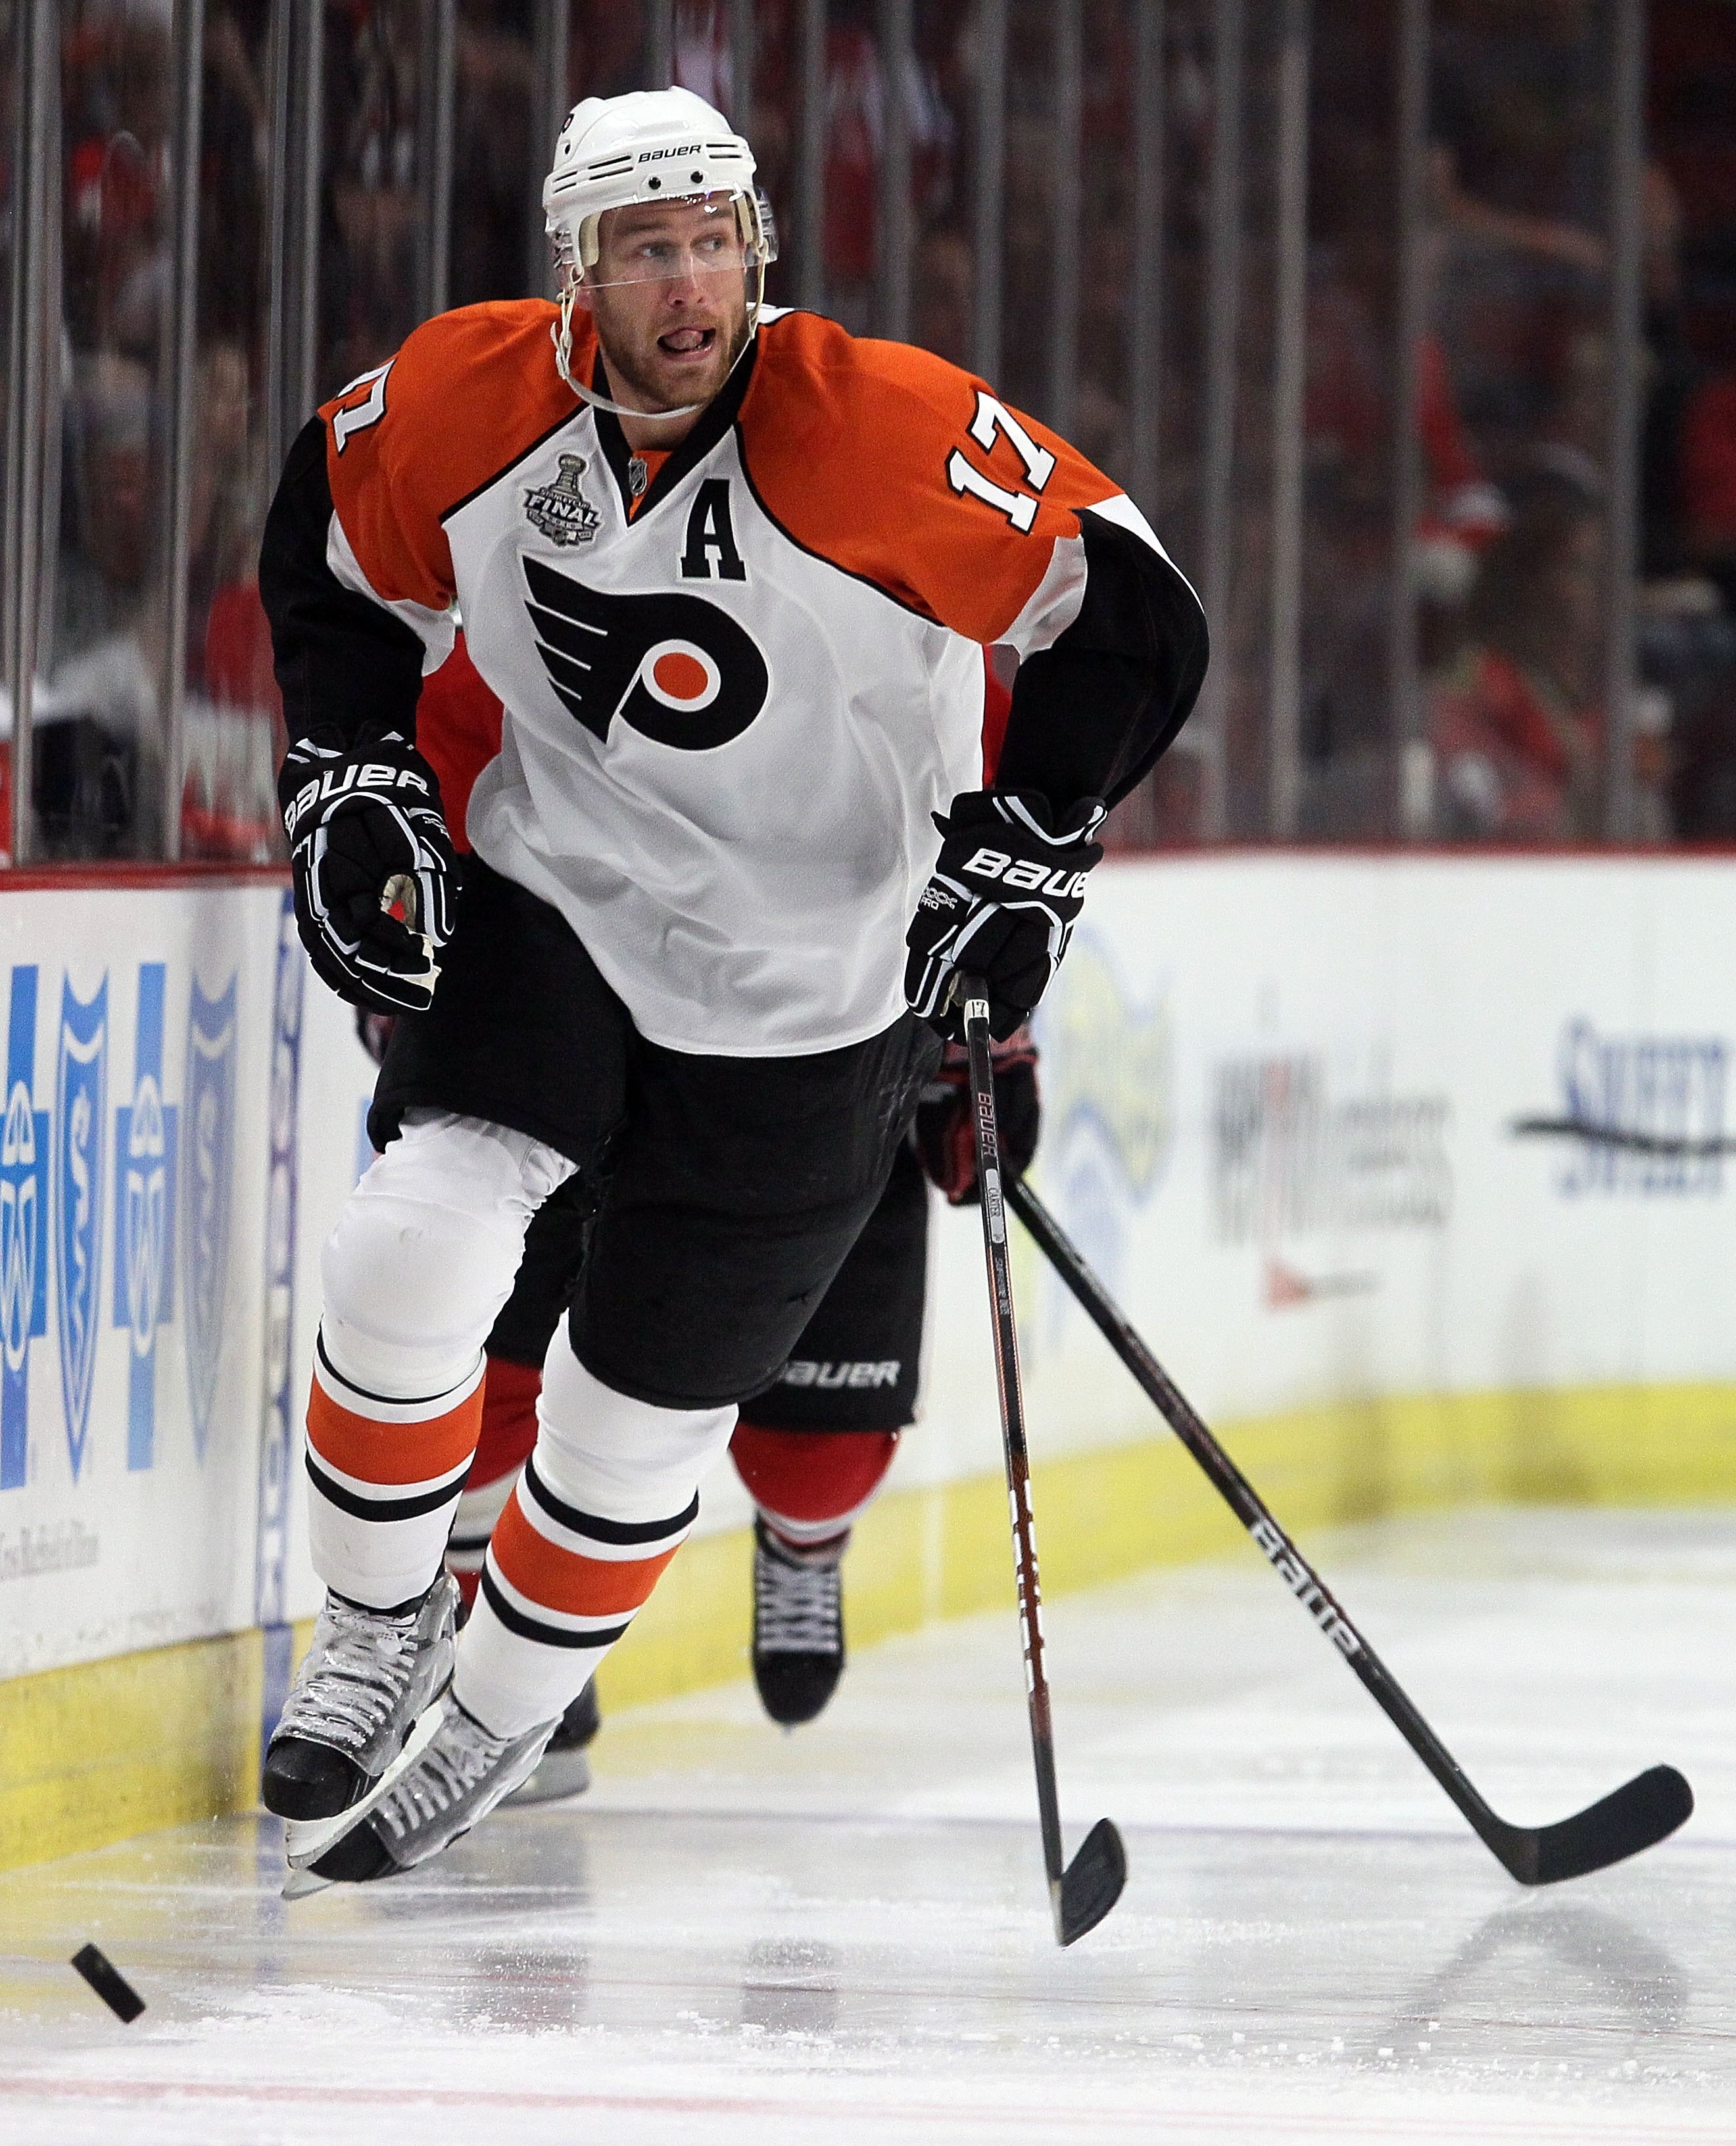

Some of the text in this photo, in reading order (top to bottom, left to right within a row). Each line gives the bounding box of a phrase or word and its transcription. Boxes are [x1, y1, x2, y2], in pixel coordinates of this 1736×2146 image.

[638, 145, 701, 163] BAUER
[948, 391, 1055, 531] 17
[528, 494, 595, 527] FINAL
[681, 479, 746, 581] A
[284, 763, 430, 842] BAUER
[962, 847, 1086, 899] BAUE
[921, 895, 939, 911] PRO
[971, 1001, 986, 1017] 17
[978, 1092, 998, 1157] BAUER
[779, 1360, 902, 1389] AUER
